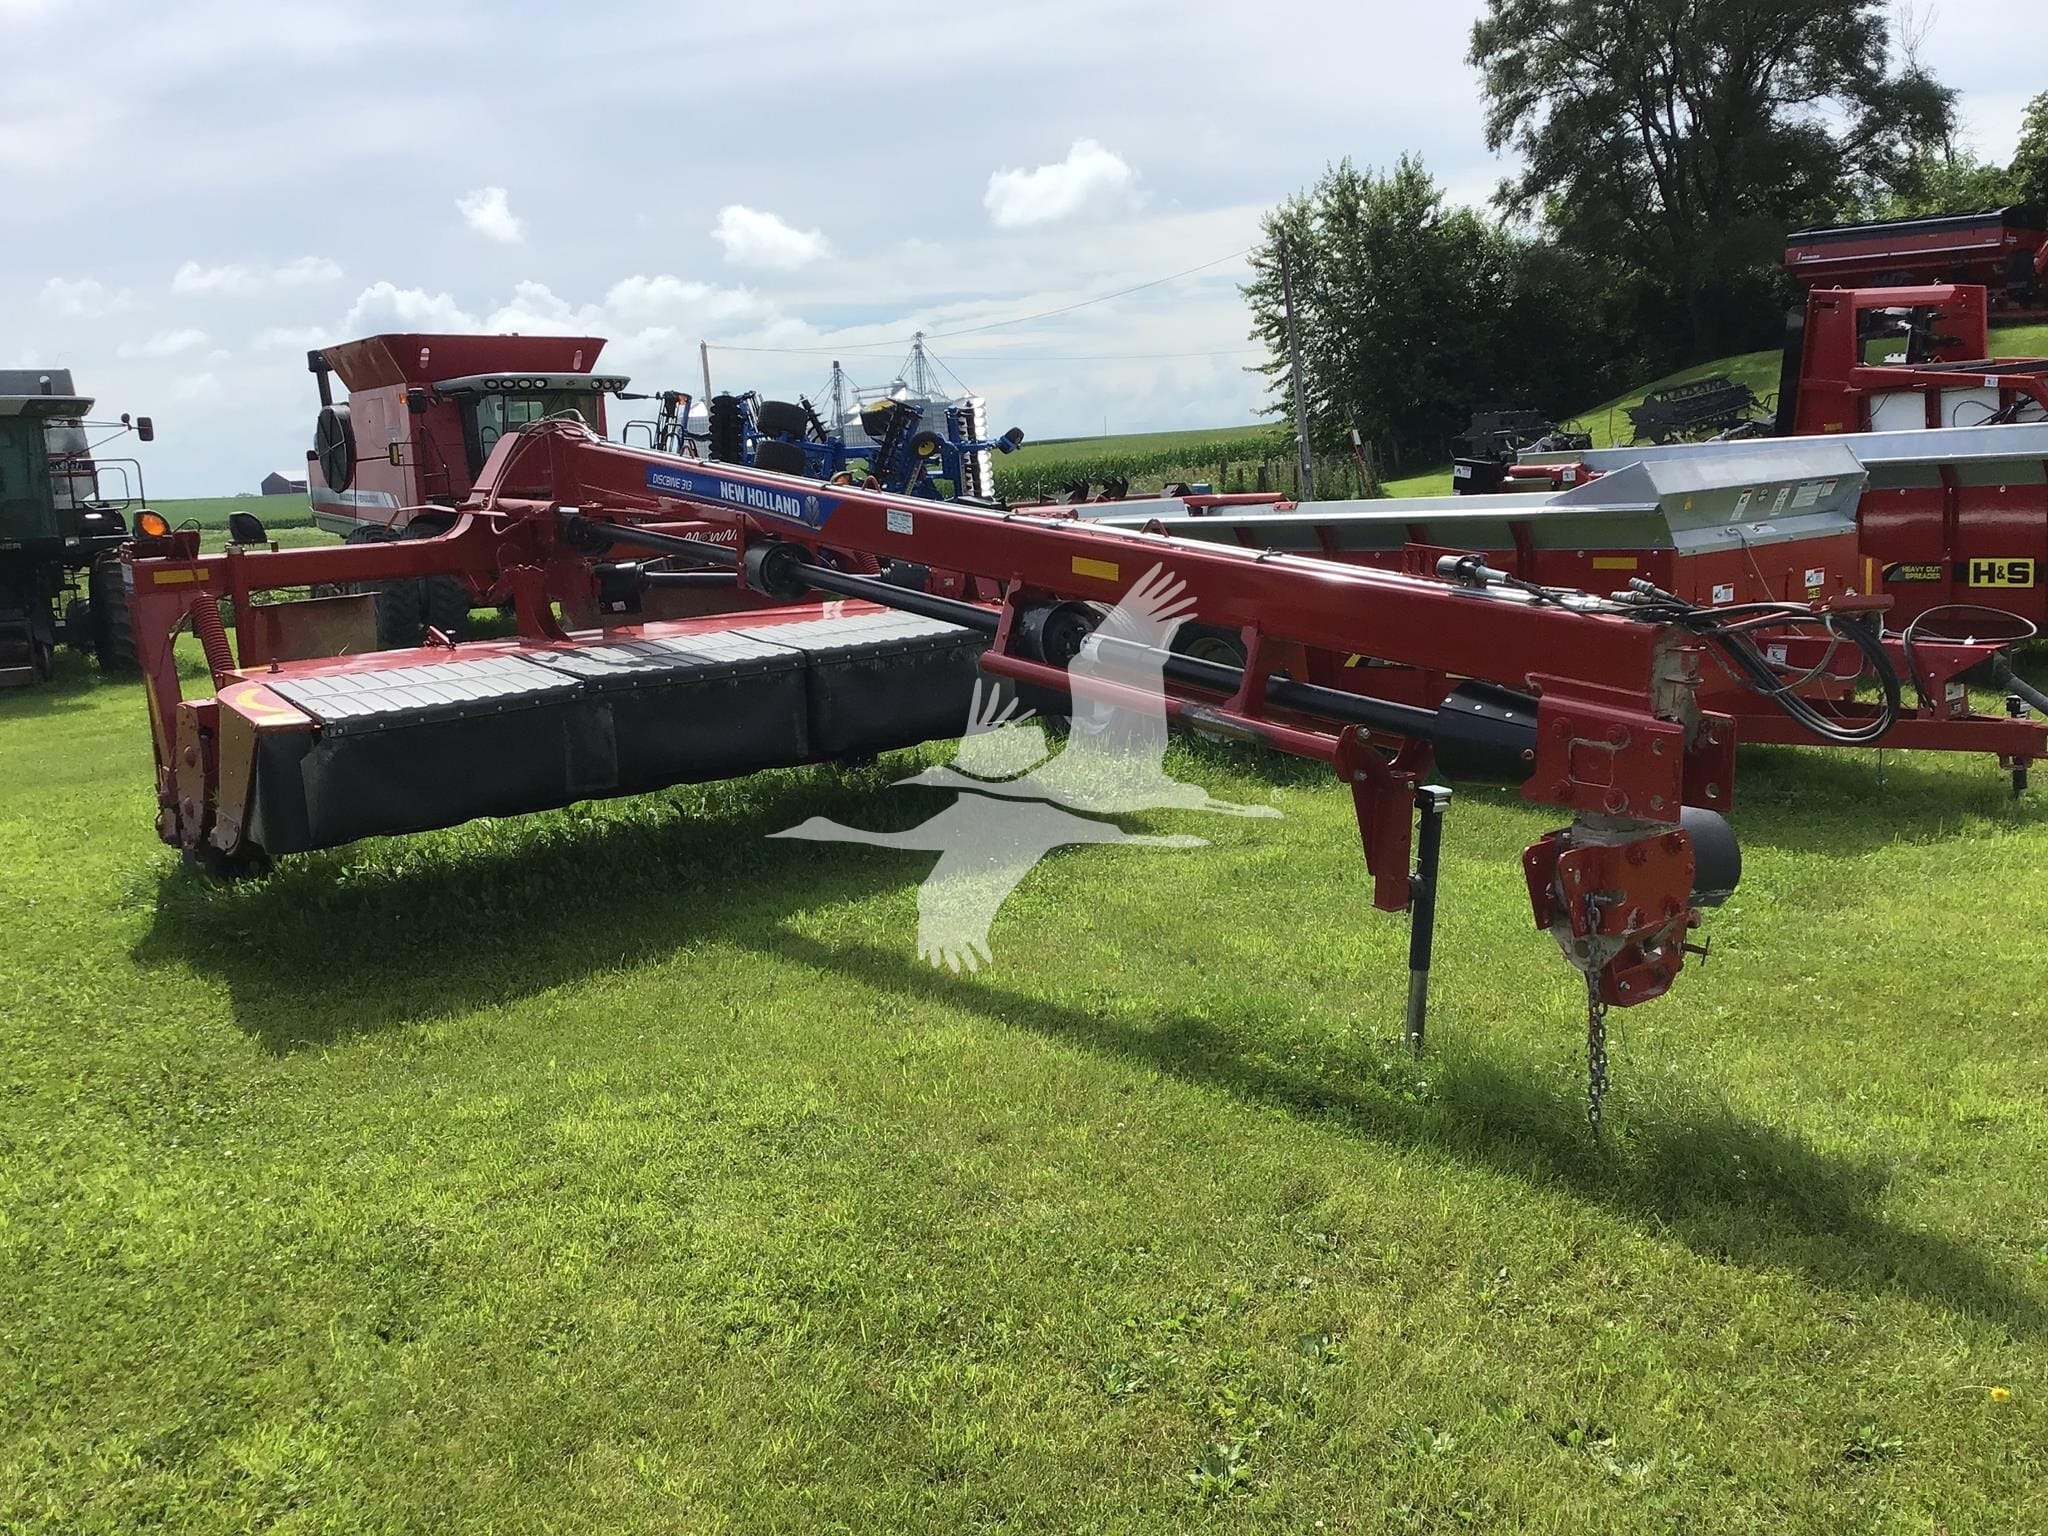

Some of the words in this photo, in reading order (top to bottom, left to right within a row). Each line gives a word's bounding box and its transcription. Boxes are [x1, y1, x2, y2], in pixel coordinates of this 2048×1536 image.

[653, 473, 680, 489] DISCBINE
[680, 480, 693, 491] 313
[720, 481, 745, 503] NEW
[747, 487, 800, 518] HOLLAND
[1901, 565, 1925, 573] HEAVY
[1905, 572, 1941, 580] SPREADER
[1973, 562, 2030, 584] H&S
